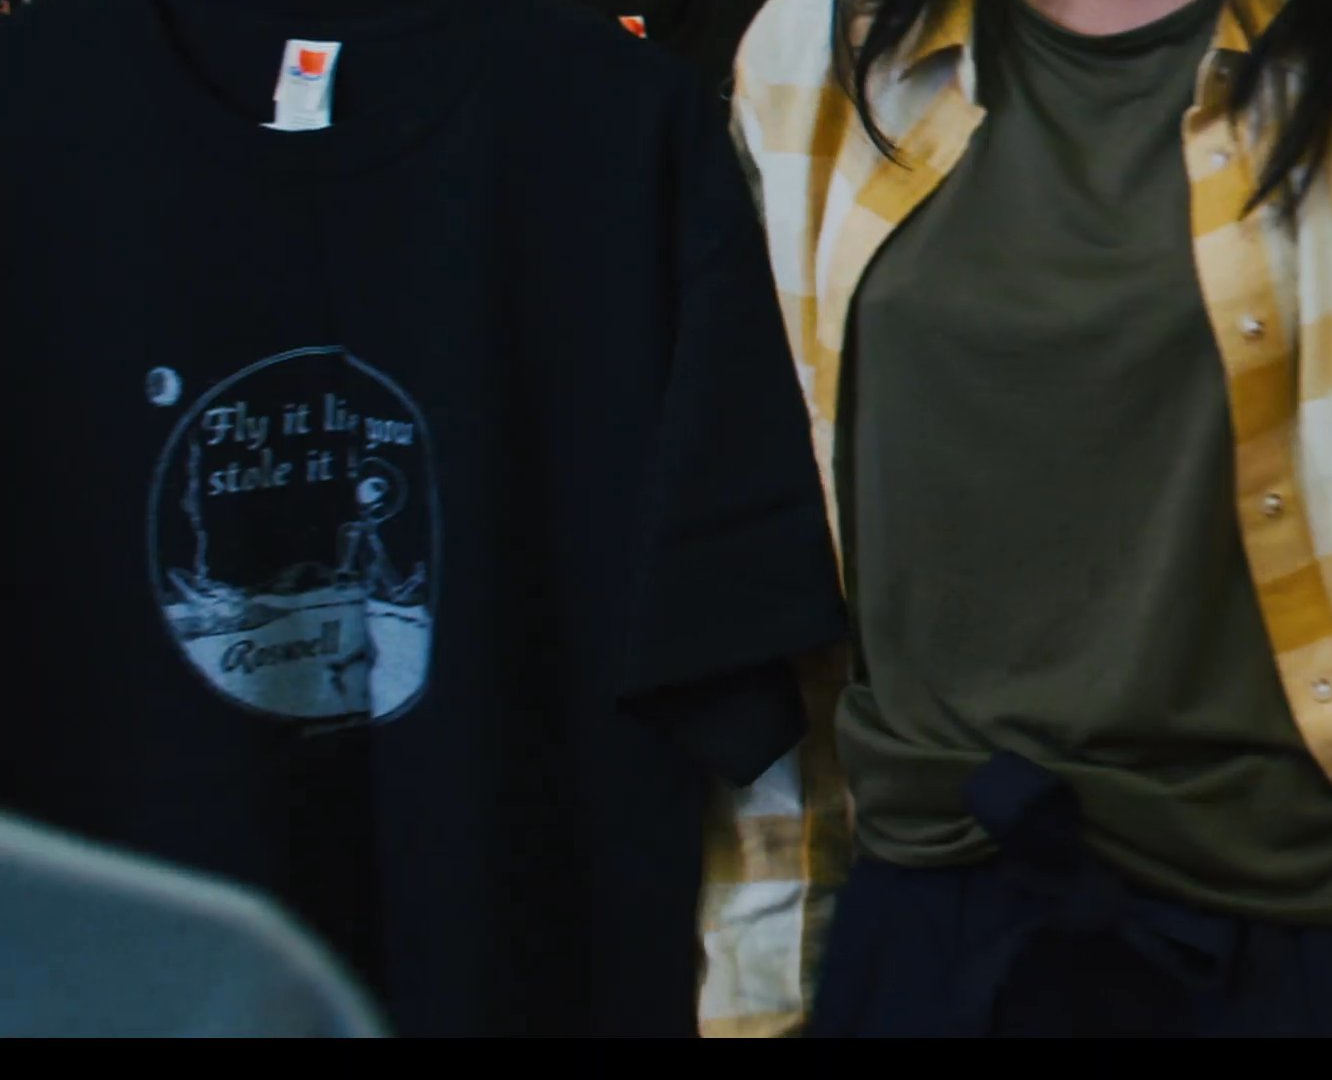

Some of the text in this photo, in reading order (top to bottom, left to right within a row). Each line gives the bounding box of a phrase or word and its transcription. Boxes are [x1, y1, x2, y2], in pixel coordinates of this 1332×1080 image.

[202, 401, 270, 451] Fly
[282, 403, 312, 436] it
[207, 447, 293, 496] stole
[306, 449, 334, 483] it
[221, 619, 341, 676] Roswell
